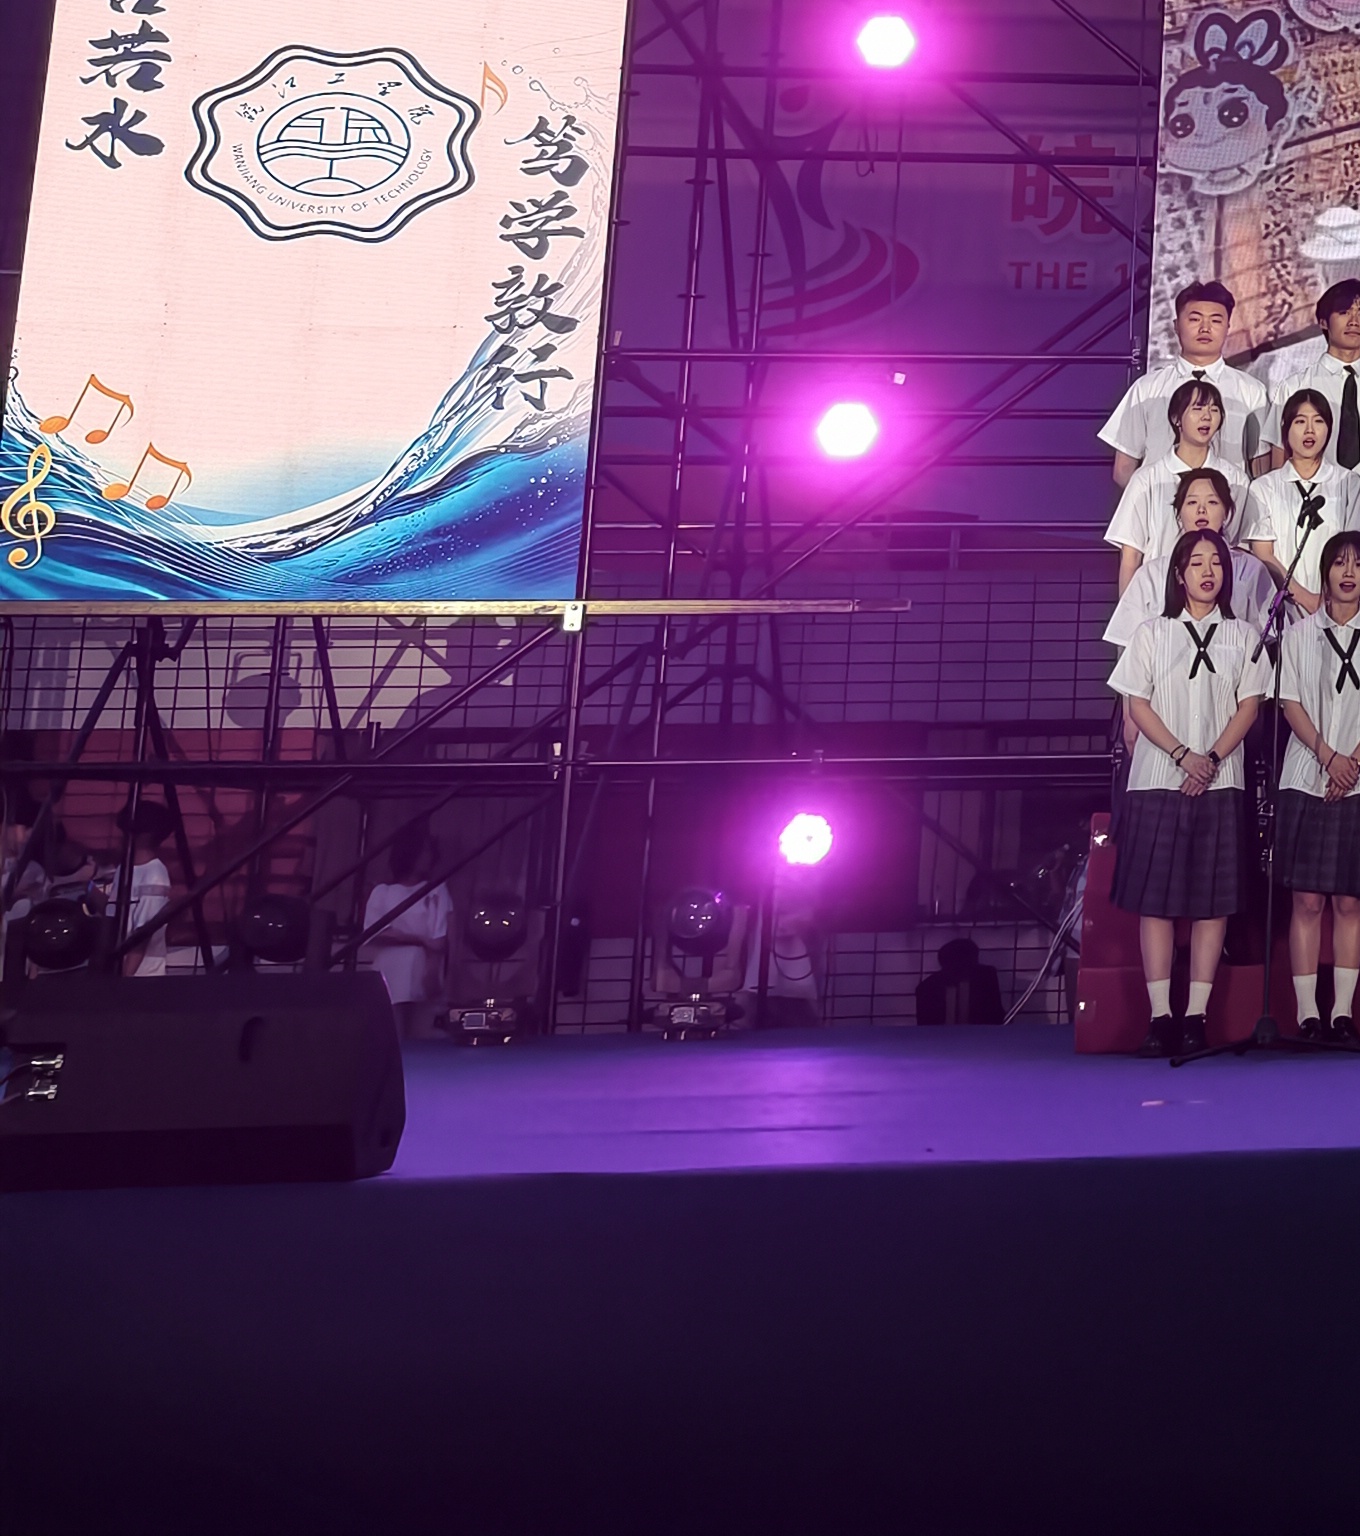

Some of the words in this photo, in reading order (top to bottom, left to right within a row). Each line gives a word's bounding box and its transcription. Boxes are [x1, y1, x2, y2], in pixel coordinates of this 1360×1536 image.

[231, 143, 267, 195] WANJIANG
[267, 193, 346, 215] UNIVERSITY
[350, 200, 369, 213] OF
[373, 147, 433, 206] TECHNOLOGY
[483, 114, 587, 413] 笃学敦行
[1008, 261, 1088, 290] THE
